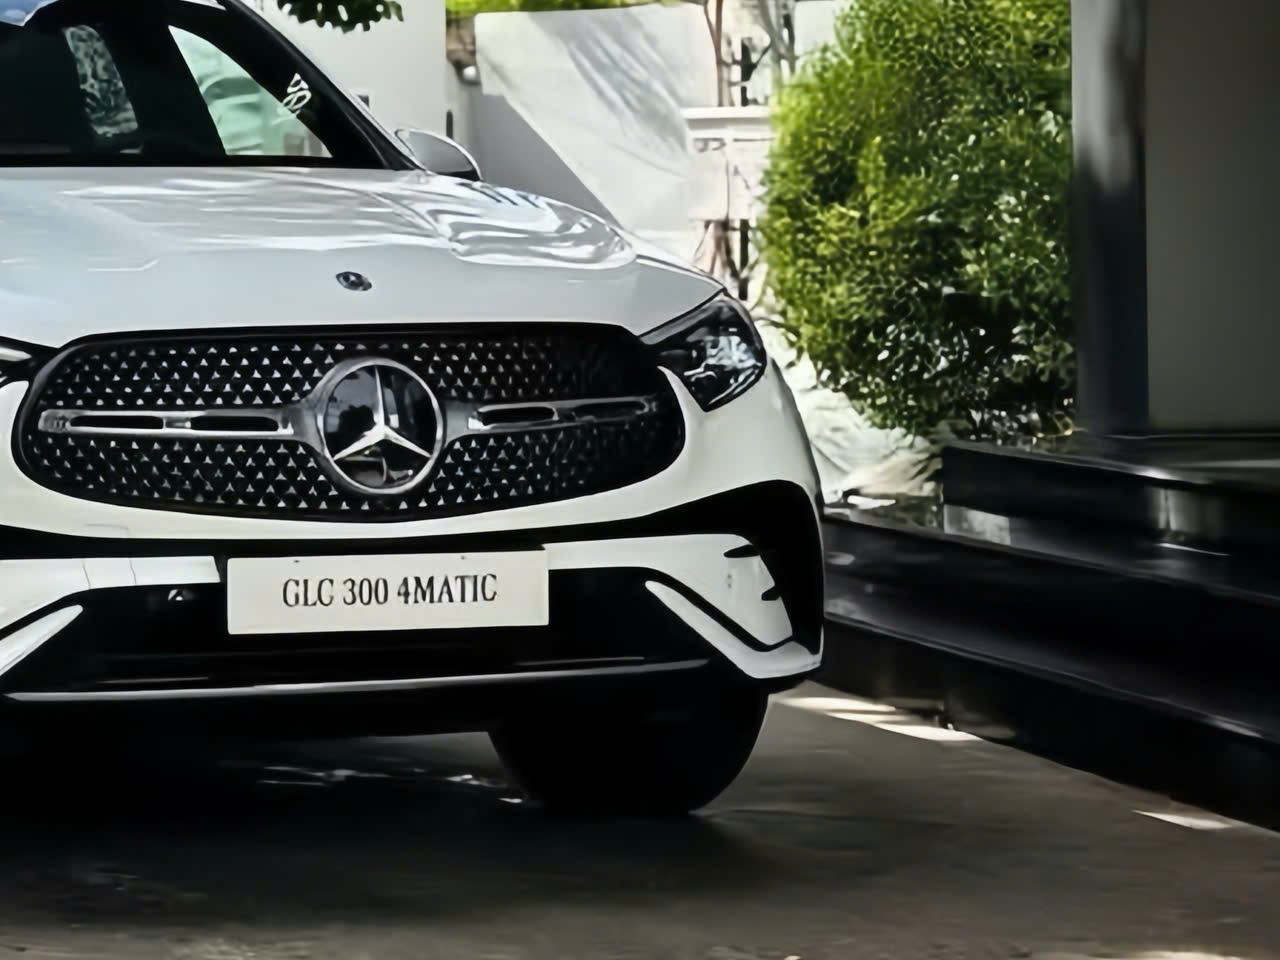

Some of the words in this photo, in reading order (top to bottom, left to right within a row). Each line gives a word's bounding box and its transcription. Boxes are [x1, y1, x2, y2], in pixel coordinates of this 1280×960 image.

[282, 577, 334, 608] GLC
[342, 577, 389, 606] 300
[397, 573, 497, 605] 4MATIC
